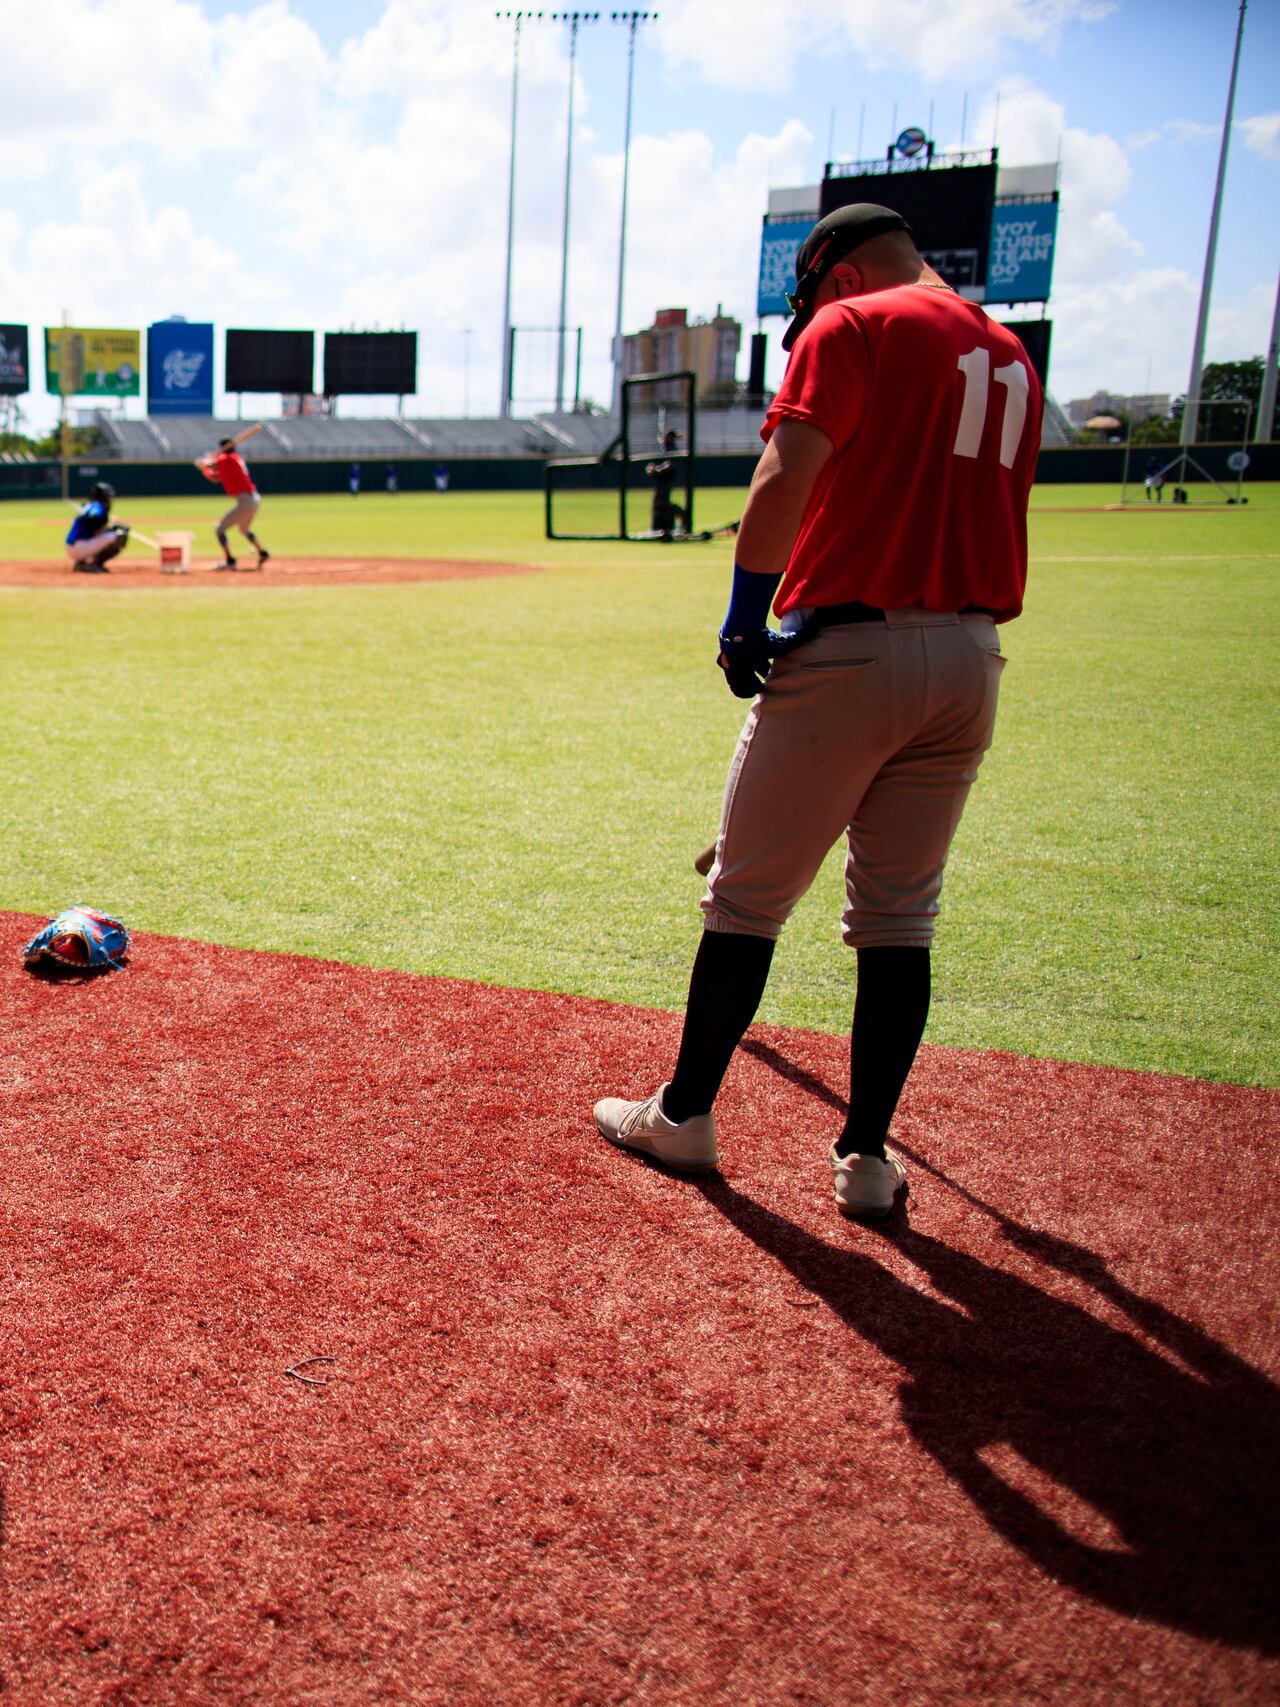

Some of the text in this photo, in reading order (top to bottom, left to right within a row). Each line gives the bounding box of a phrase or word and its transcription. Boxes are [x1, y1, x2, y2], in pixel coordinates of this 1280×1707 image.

[996, 221, 1037, 236] VOY
[765, 239, 800, 254] VOY
[995, 234, 1053, 251] TURIS
[993, 247, 1049, 265] TEAN
[991, 263, 1020, 276] DO
[952, 346, 1029, 470] 11
